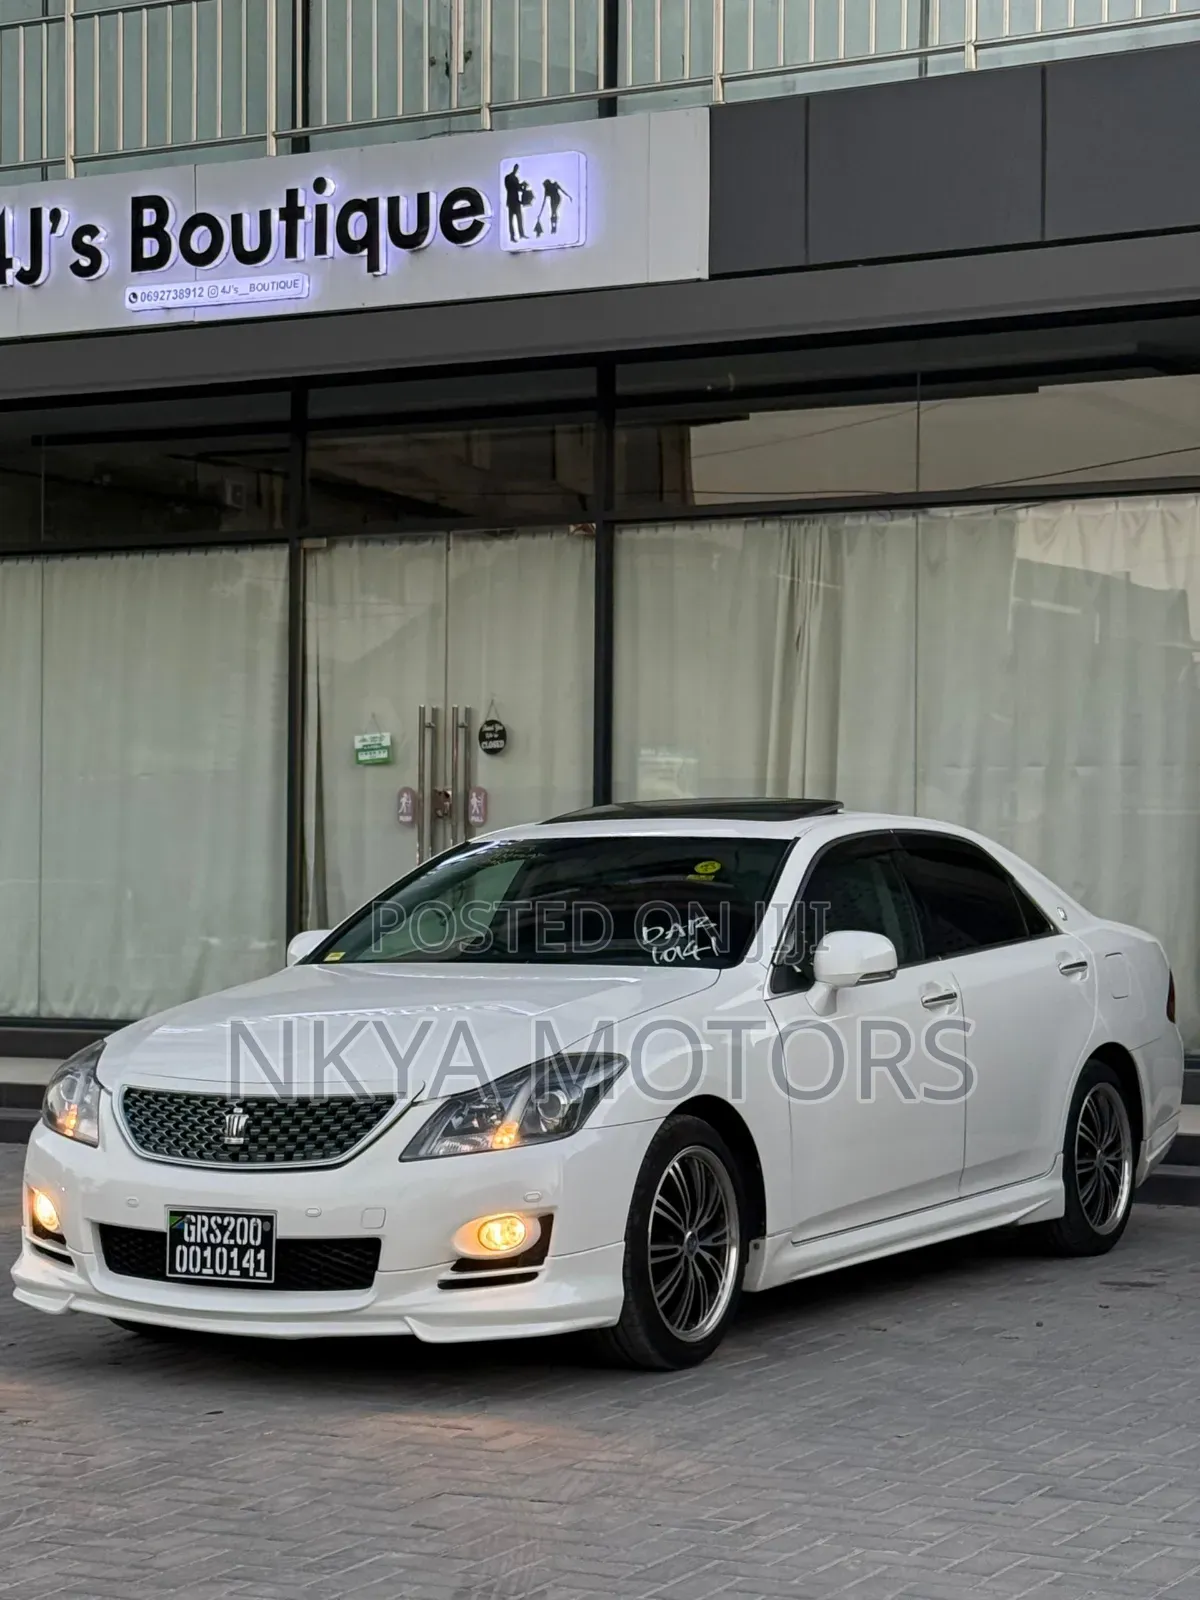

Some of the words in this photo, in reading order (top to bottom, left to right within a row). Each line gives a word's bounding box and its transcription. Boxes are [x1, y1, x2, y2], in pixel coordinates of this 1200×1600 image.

[131, 177, 489, 276] Boutique
[140, 286, 205, 302] 0692738912
[183, 1214, 262, 1246] GRS200
[175, 1244, 268, 1278] 0010141
